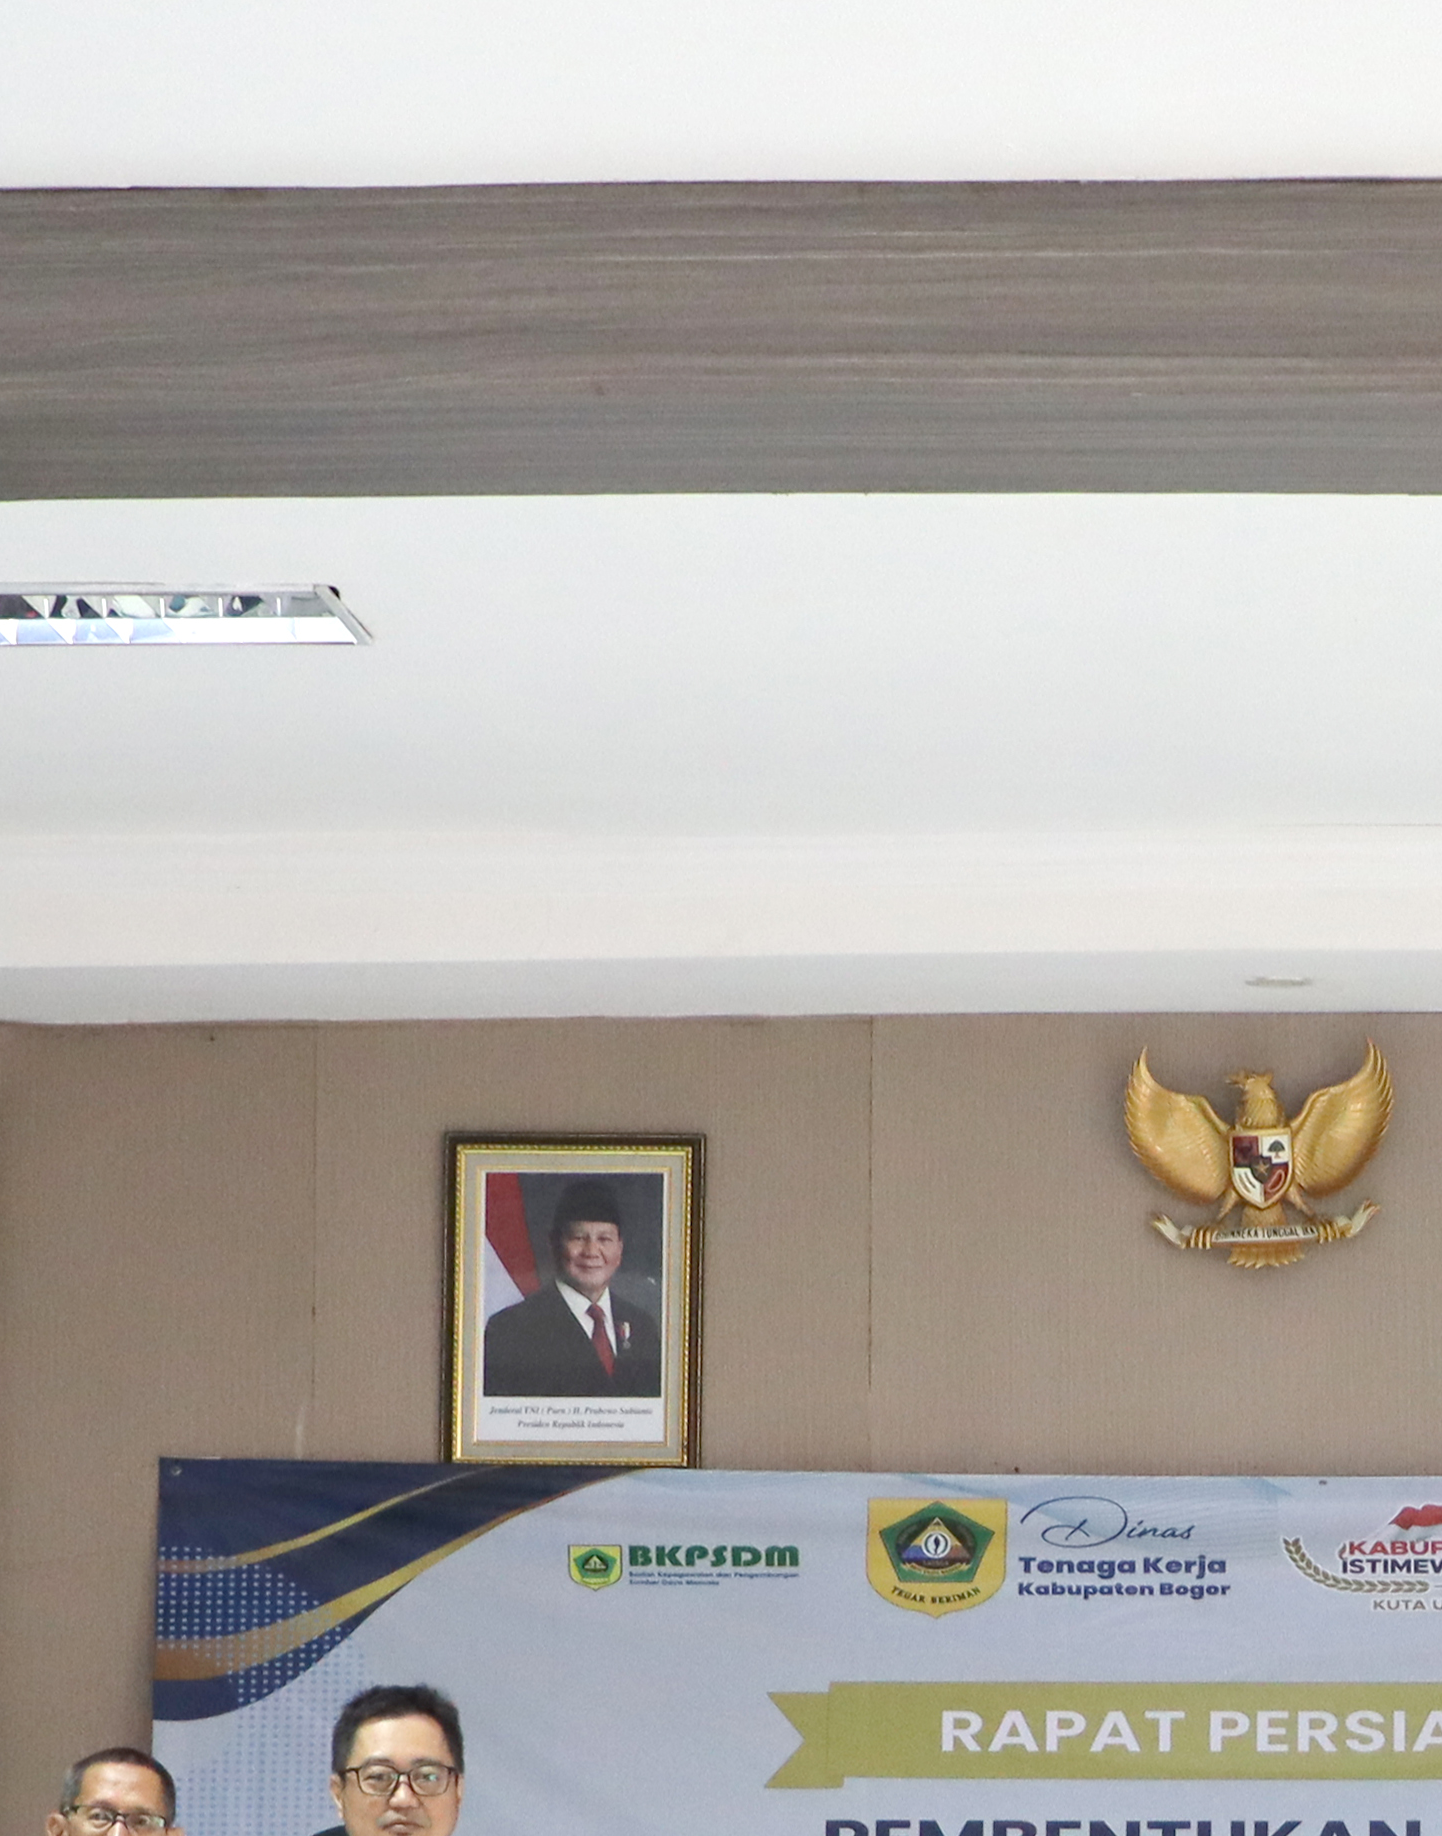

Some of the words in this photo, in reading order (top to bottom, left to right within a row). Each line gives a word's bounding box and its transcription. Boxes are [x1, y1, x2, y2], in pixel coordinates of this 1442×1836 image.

[1019, 1495, 1196, 1549] Dinas
[628, 1545, 800, 1568] BKPSDM
[1018, 1555, 1138, 1580] Tenaga
[1141, 1554, 1227, 1580] Kerja
[1017, 1581, 1155, 1601] Kabupaten
[1158, 1582, 1231, 1601] Bogor
[1373, 1599, 1426, 1611] KUTA
[941, 1710, 1186, 1753] RAPAT
